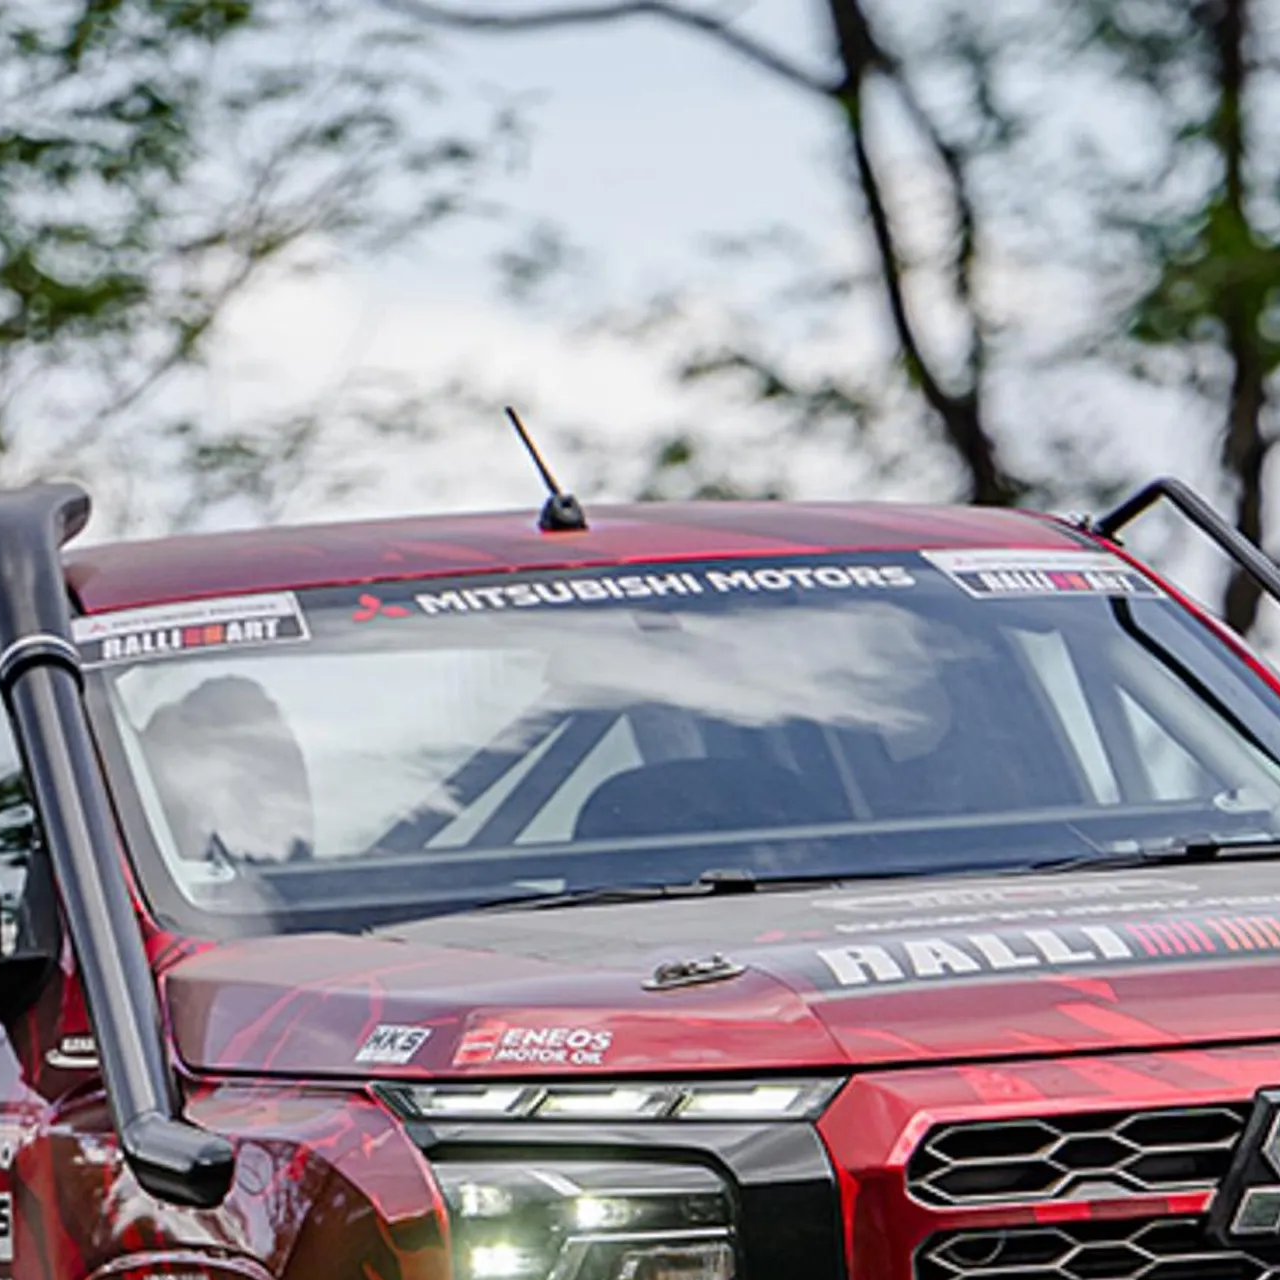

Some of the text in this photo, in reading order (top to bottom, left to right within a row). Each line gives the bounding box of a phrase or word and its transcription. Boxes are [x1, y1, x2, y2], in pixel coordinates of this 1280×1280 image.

[415, 565, 917, 616] MITSUBISHI MOTORS
[102, 618, 280, 660] RALLI ART
[817, 925, 1133, 986] RALLI
[495, 1047, 603, 1065] MOTOR OIL
[503, 1027, 613, 1049] ENEOS
